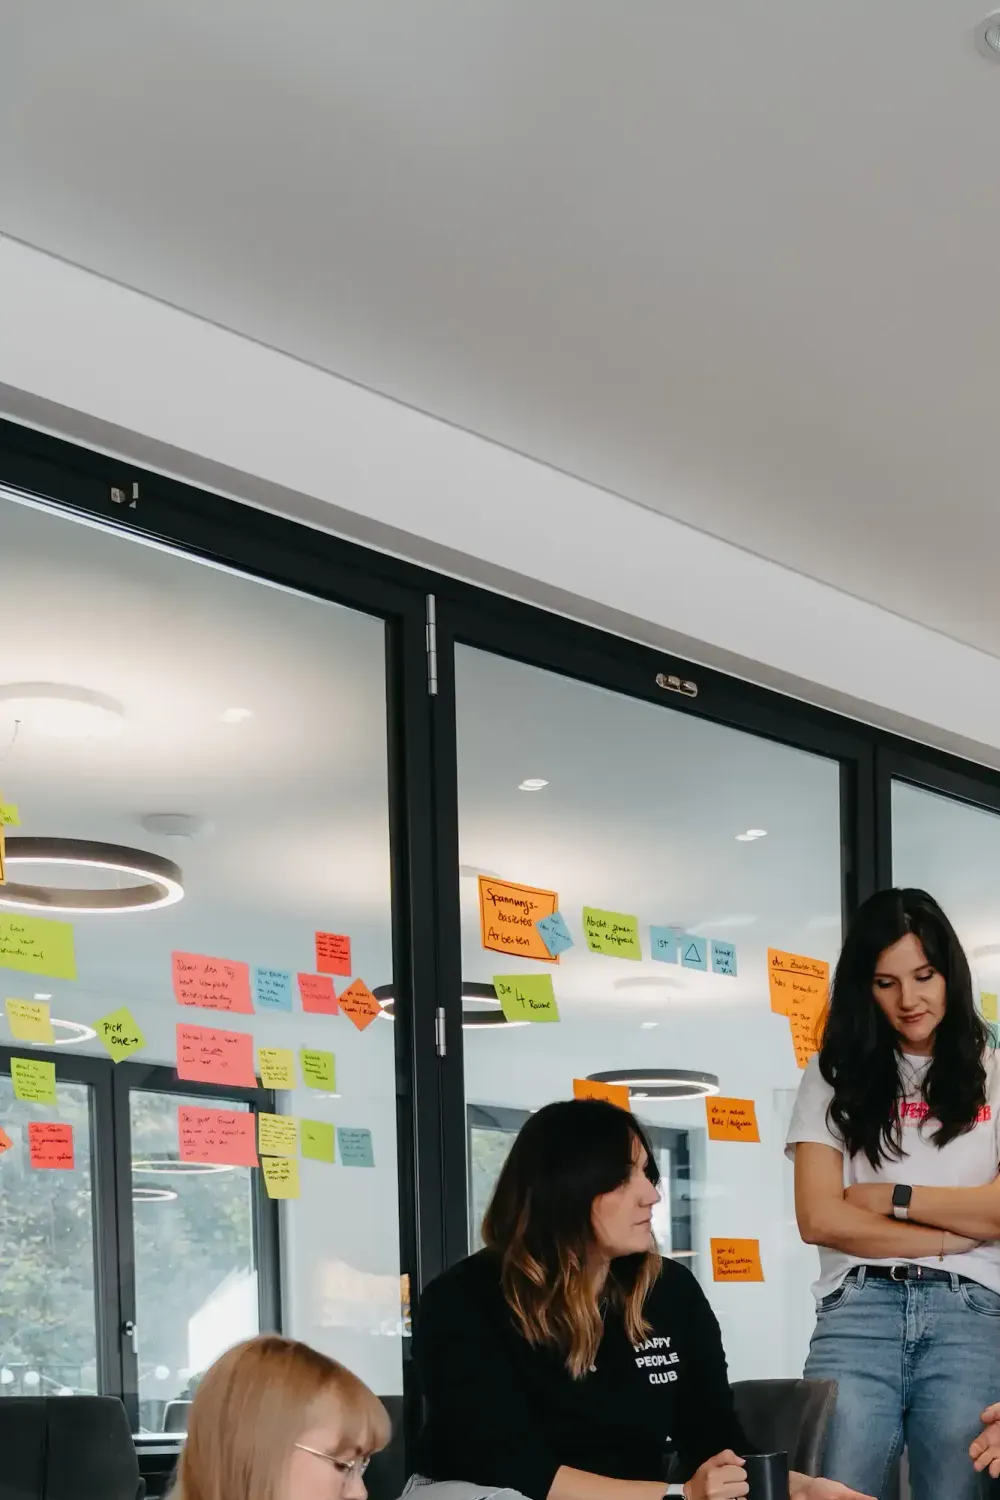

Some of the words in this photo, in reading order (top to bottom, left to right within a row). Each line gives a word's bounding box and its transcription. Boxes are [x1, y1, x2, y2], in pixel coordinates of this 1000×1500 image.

[486, 887, 539, 915] Spannungs-
[487, 926, 531, 946] Arbeiten
[514, 987, 526, 1009] 4
[633, 1336, 671, 1353] HAPPY
[635, 1352, 680, 1368] PEOPLE
[649, 1370, 679, 1385] CLUB
